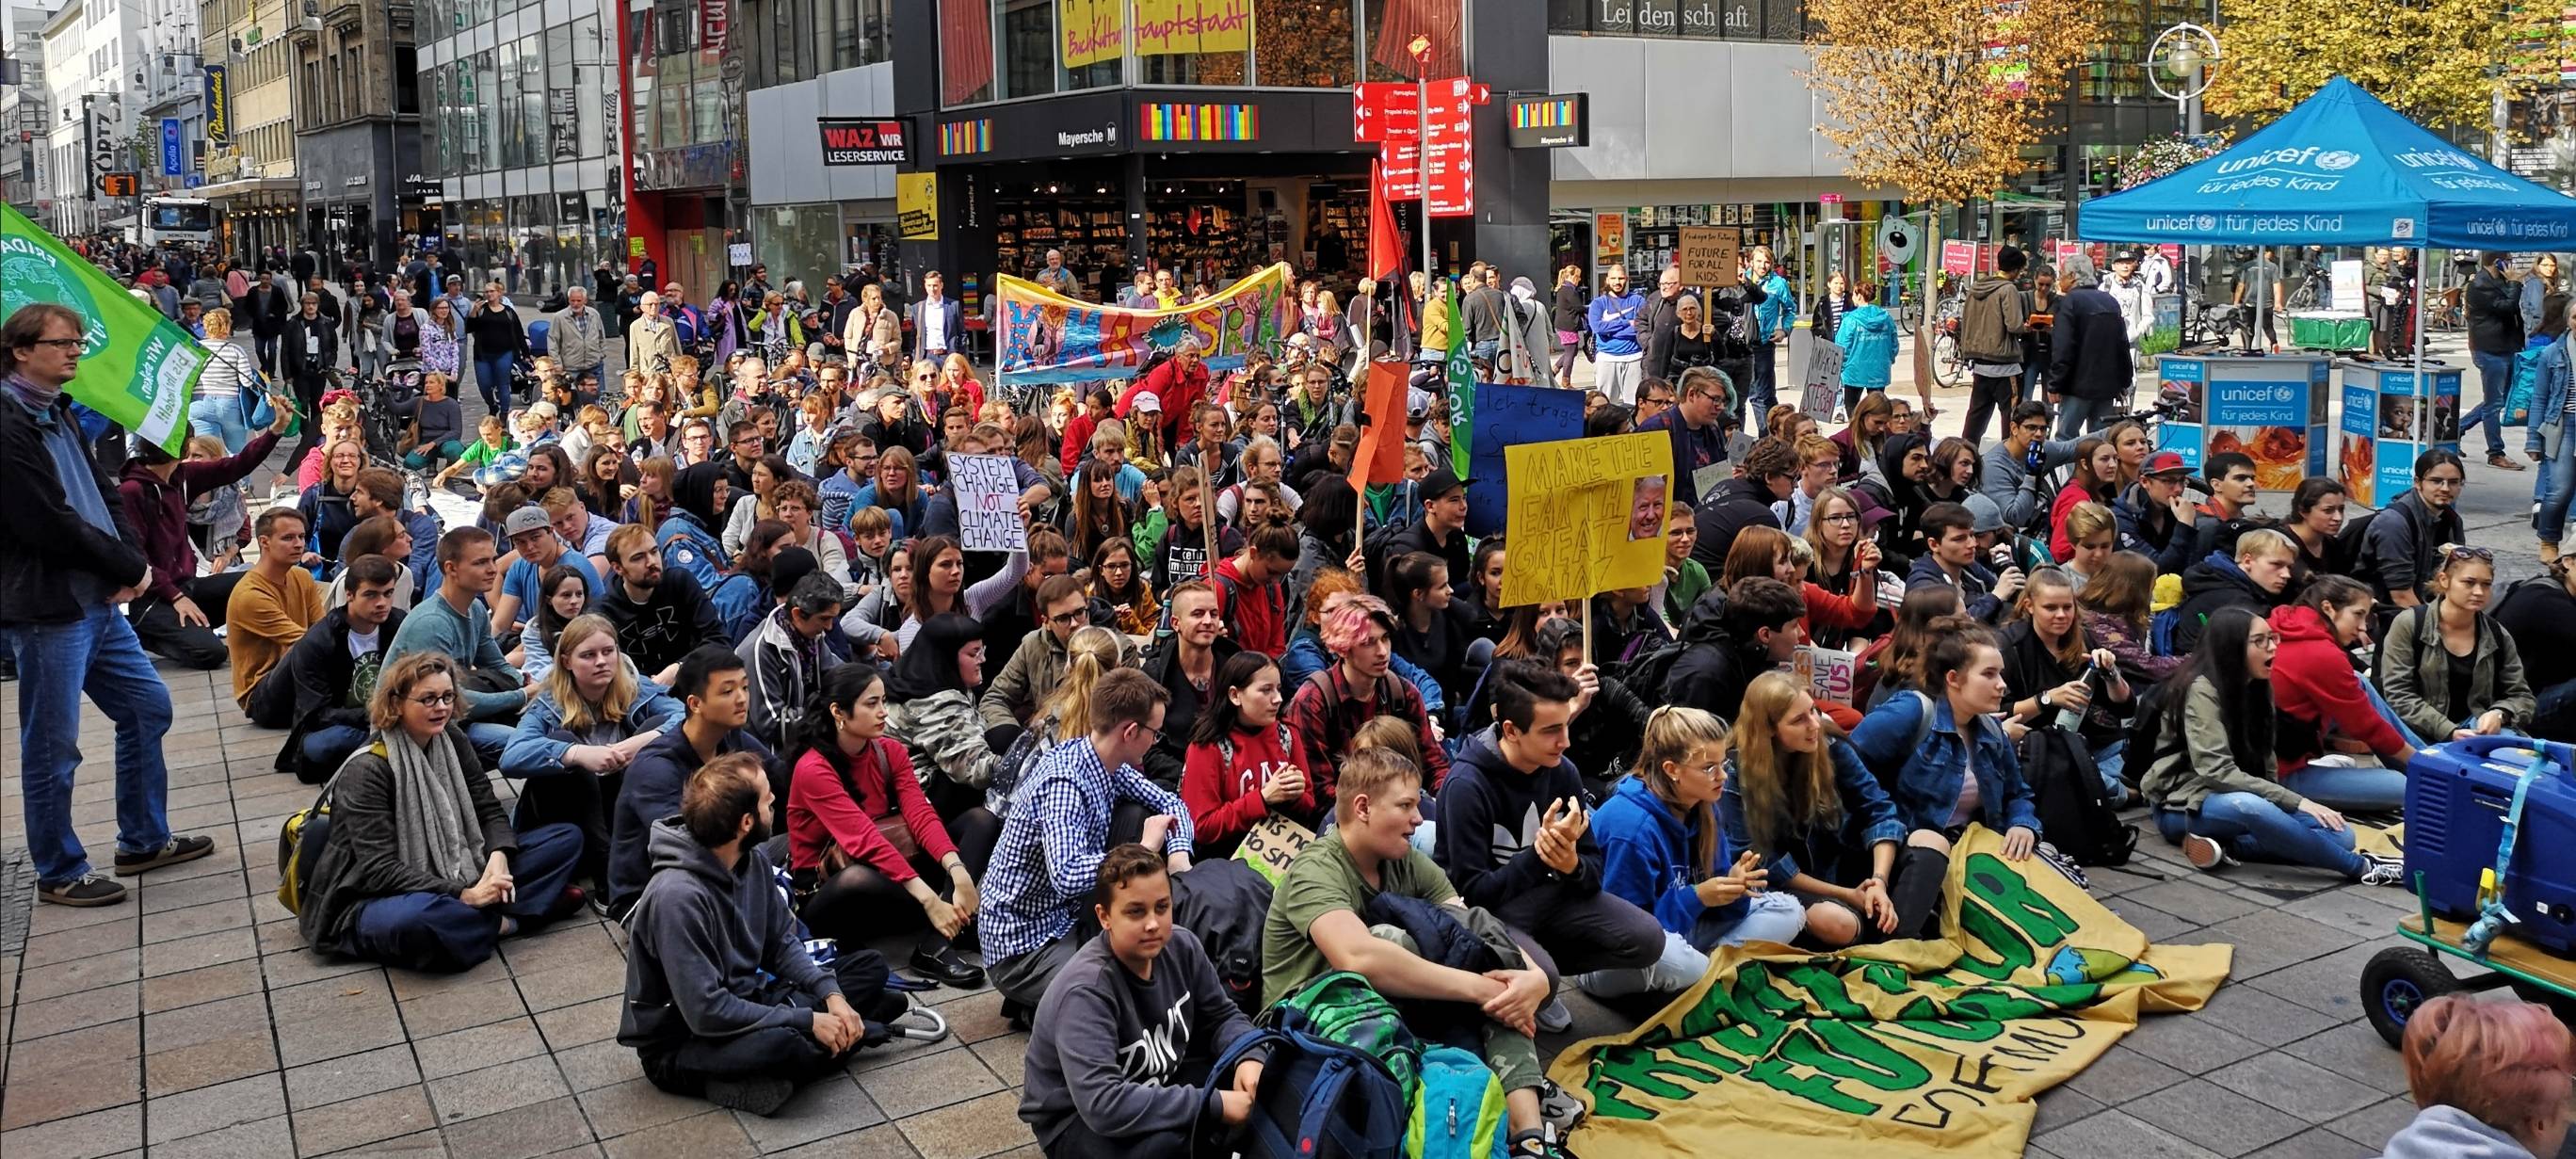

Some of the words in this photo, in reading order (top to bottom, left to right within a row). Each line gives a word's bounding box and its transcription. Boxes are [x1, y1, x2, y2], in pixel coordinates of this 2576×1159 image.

[825, 129, 875, 148] WAZ
[879, 134, 903, 146] WR
[1058, 129, 1103, 148] Mayersche
[1541, 137, 1567, 145] Mayersche
[169, 145, 180, 171] Apollo
[829, 151, 905, 162] LESERSERVICE
[2217, 146, 2320, 174] unicef
[406, 174, 424, 183] JA
[2197, 182, 2230, 194] für
[2224, 174, 2282, 193] jedes
[2285, 176, 2340, 191] Kind
[2147, 215, 2195, 231] unicef
[2226, 215, 2250, 232] für
[2252, 214, 2299, 234] jedes
[2303, 215, 2343, 232] Kind
[2467, 217, 2496, 235] unicef
[2511, 217, 2523, 236] für
[2524, 219, 2549, 240] jedes
[2550, 220, 2568, 238] Kind
[1688, 248, 1730, 259] FUTURE
[1688, 260, 1705, 268] FOR
[1707, 260, 1723, 269] ALL
[1696, 271, 1718, 282] KIDS
[2389, 375, 2414, 383] unicef
[1487, 388, 1516, 412] Ich
[2222, 386, 2273, 401] unicef
[2345, 392, 2365, 409] unicef
[2222, 410, 2236, 421] für
[2238, 411, 2268, 422] jedes
[2270, 410, 2294, 421] Kind
[948, 455, 1013, 477] SYSTEM
[1524, 442, 1603, 493] MAKE
[1602, 435, 1652, 475] THE
[2381, 465, 2409, 475] unicef
[954, 474, 1019, 494] CHANGE
[975, 493, 1004, 512] NOT
[1520, 479, 1624, 538] EARTH
[960, 509, 1022, 530] CLIMATE
[962, 528, 1025, 550] CHANGE
[1509, 515, 1627, 579] GREAT
[1813, 654, 1831, 701] SAVE
[1240, 761, 1289, 798] GA
[1246, 829, 1264, 852] to
